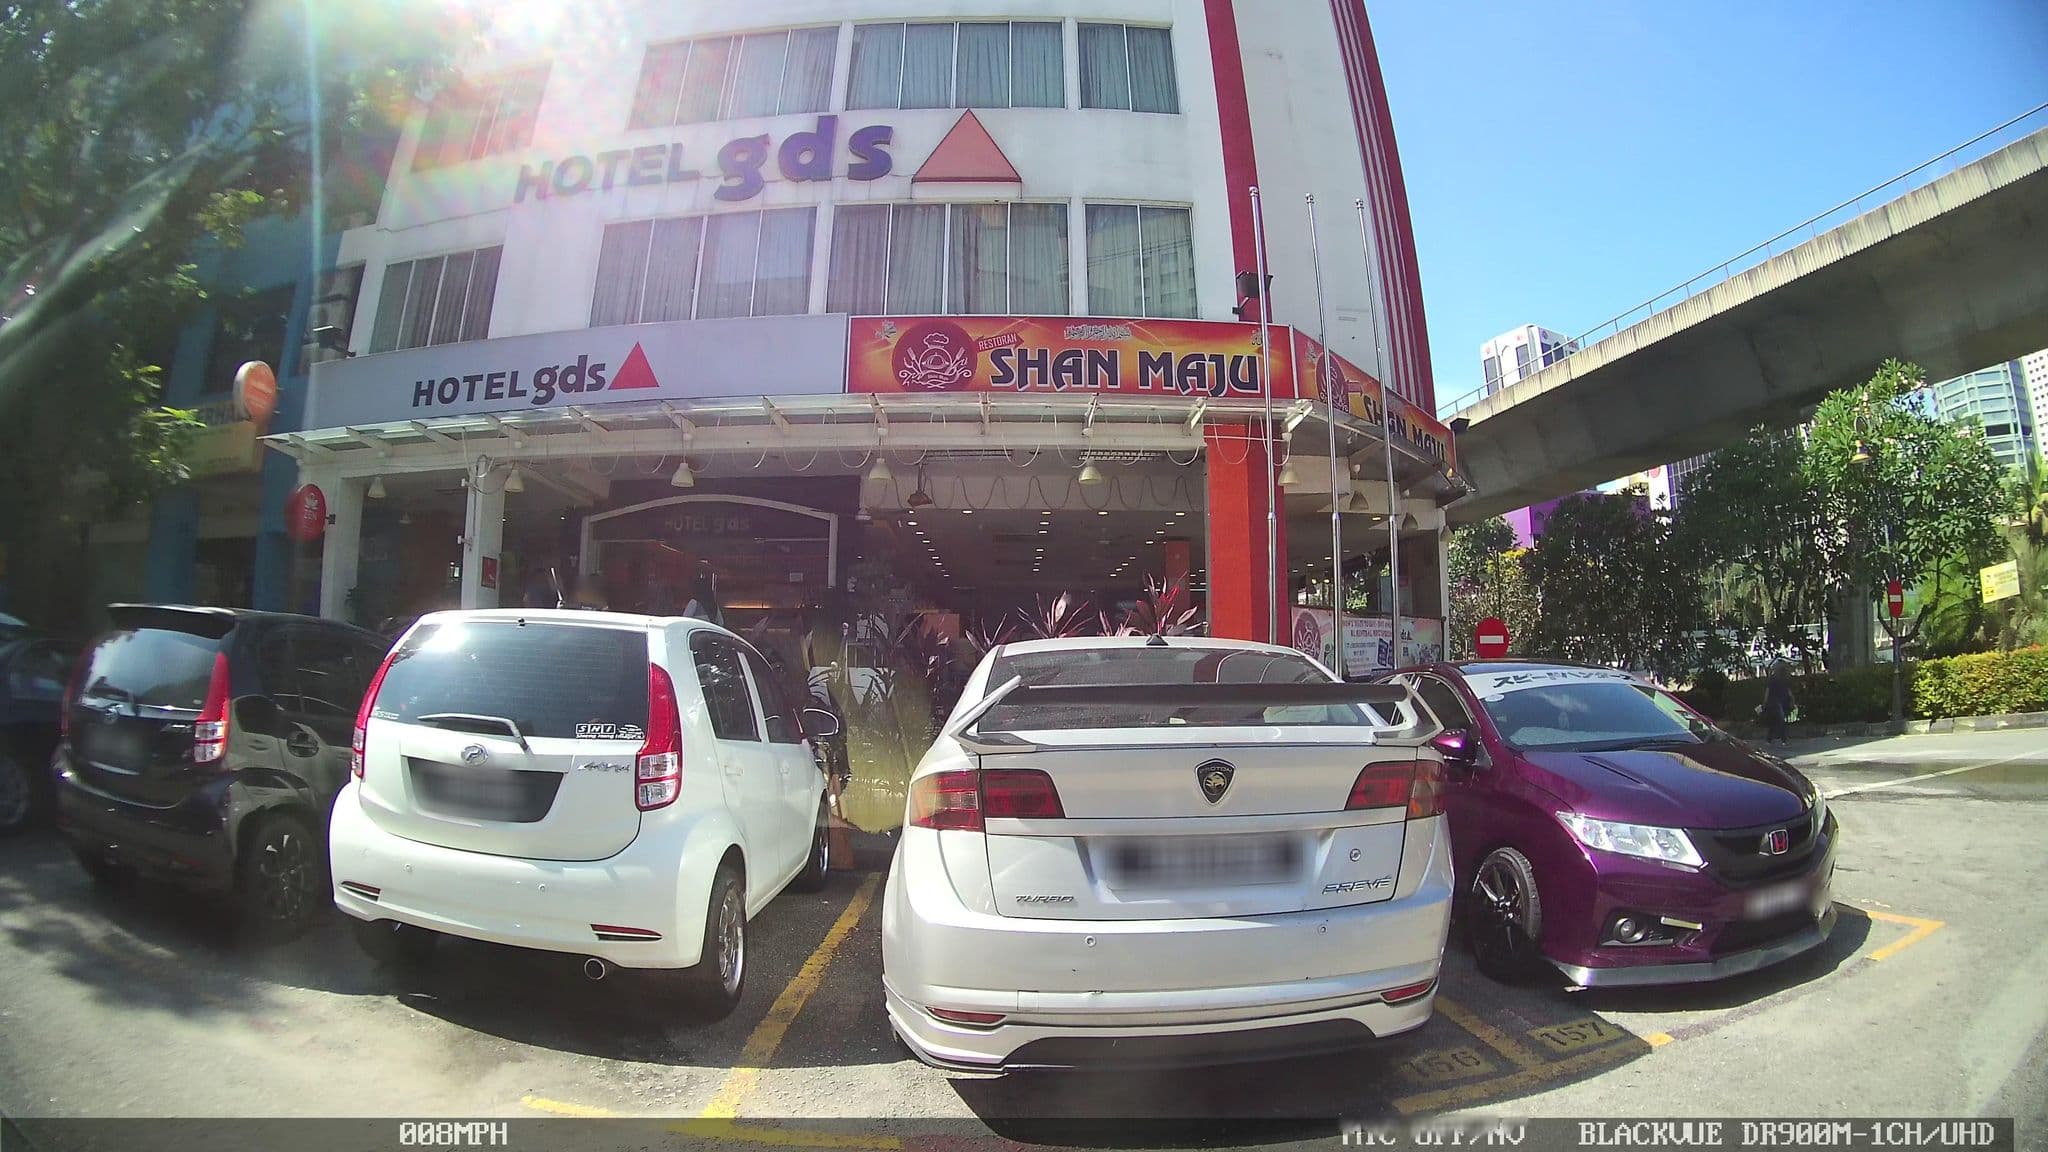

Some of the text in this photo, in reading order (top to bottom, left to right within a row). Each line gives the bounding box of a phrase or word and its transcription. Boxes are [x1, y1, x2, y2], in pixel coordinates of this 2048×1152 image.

[514, 114, 894, 203] HOTEL gds
[978, 333, 1018, 351] RESTORAN
[412, 354, 606, 407] HOTEL gds
[989, 347, 1122, 393] SHAN
[1138, 349, 1262, 397] MAJU
[1540, 1020, 1605, 1047] 157
